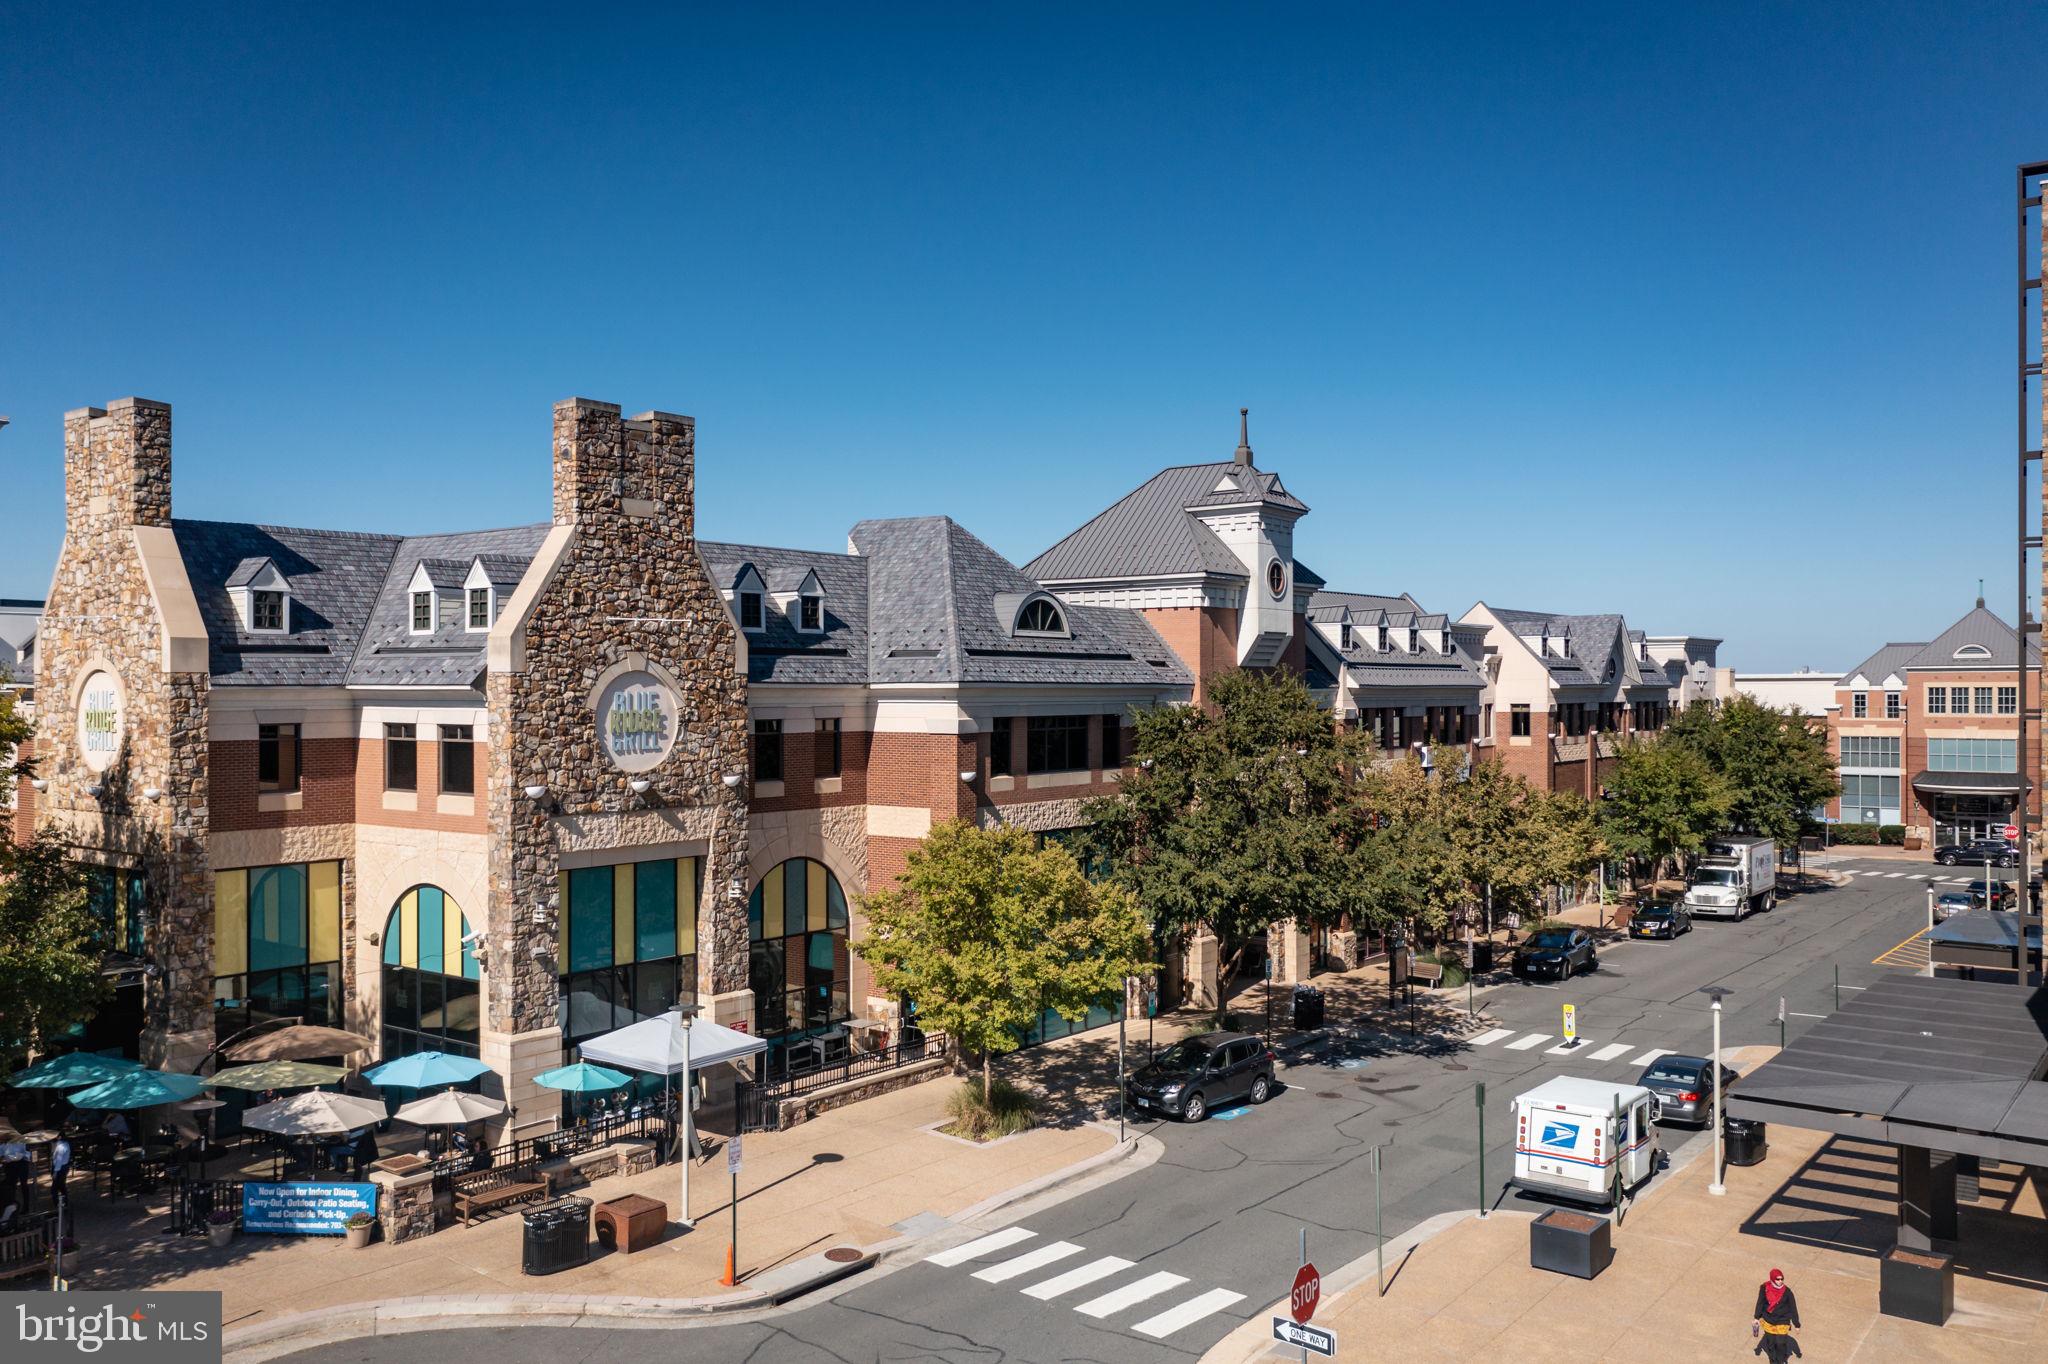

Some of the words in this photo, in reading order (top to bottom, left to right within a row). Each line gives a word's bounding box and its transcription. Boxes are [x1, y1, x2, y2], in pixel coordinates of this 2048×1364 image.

[613, 691, 661, 712] BLUE
[610, 708, 663, 734] RIDGE
[611, 730, 663, 752] GRILL
[259, 1187, 275, 1196] Now
[276, 1187, 295, 1198] Open
[296, 1187, 307, 1196] for
[309, 1187, 332, 1196] Indoor
[333, 1187, 360, 1198] Dining,
[248, 1198, 286, 1209] Carry-Out,
[287, 1199, 316, 1207] Outdoor
[318, 1199, 338, 1208] Patio
[338, 1199, 370, 1210] Seating,
[268, 1210, 282, 1218] and
[283, 1210, 316, 1219] Curbside
[317, 1210, 349, 1221] Pick-Up.
[1293, 1278, 1318, 1311] STOP
[1290, 1328, 1307, 1341] ONE
[1309, 1333, 1326, 1347] WAY
